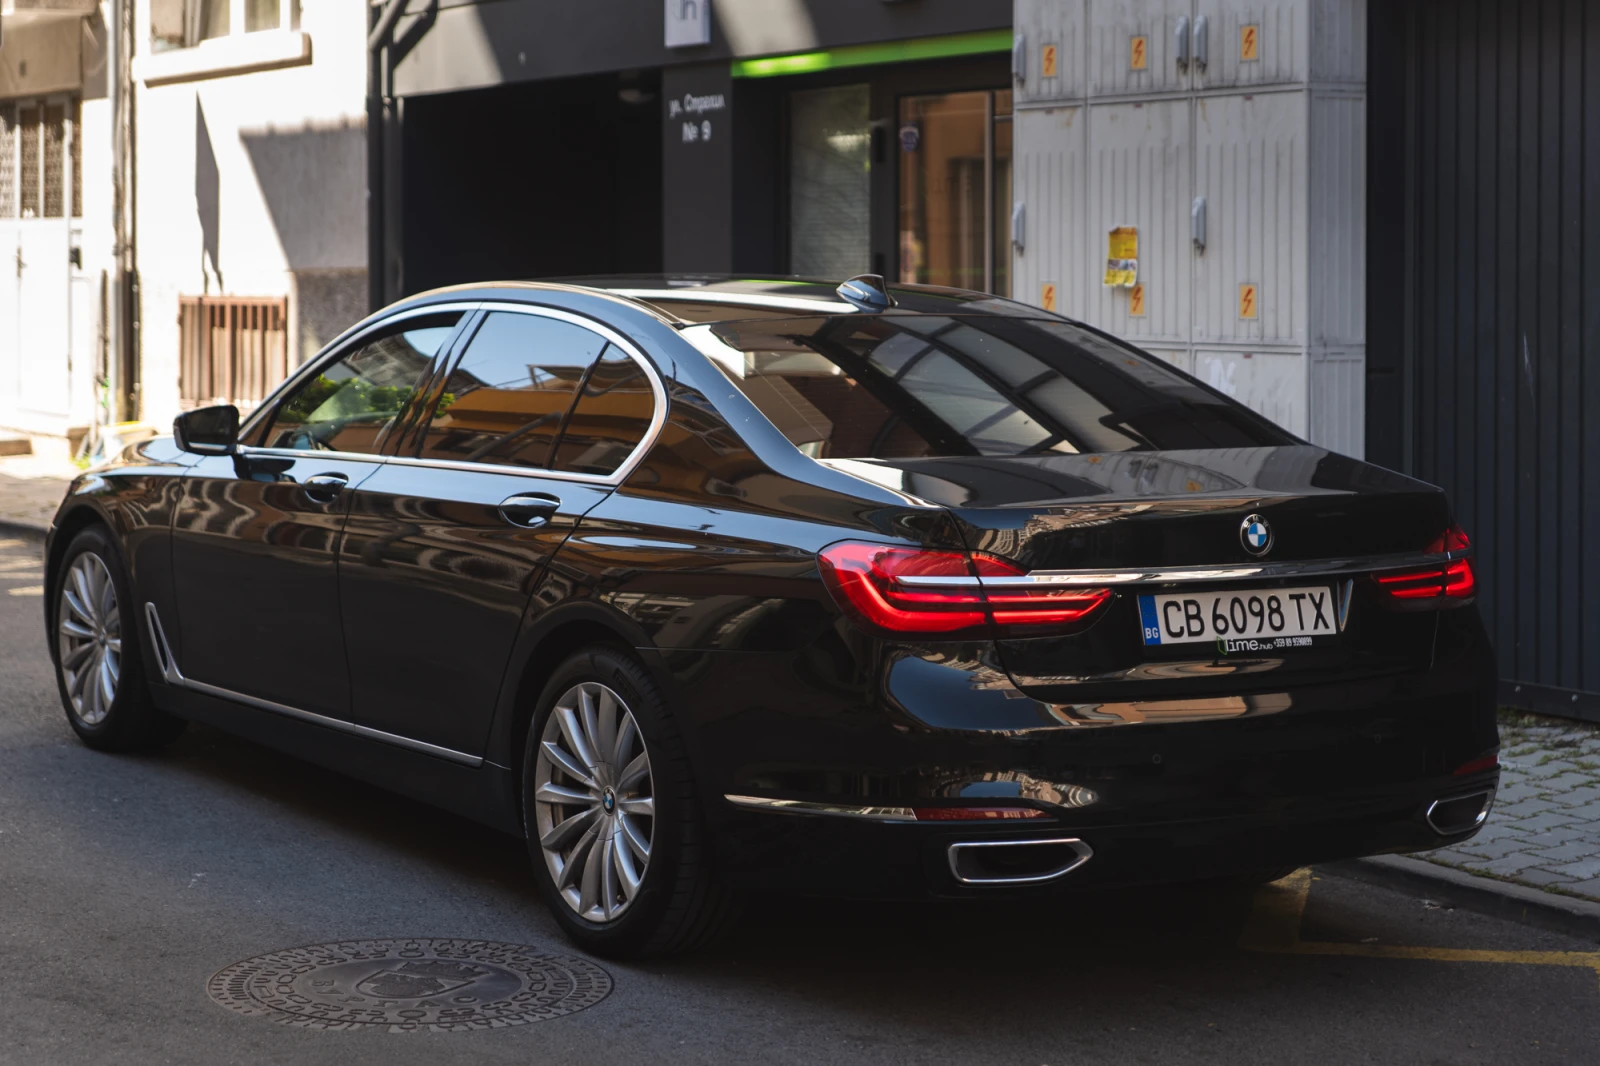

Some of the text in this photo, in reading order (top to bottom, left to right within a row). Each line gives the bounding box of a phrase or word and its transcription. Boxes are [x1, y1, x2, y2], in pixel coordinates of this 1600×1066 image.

[701, 120, 711, 141] 9
[1163, 592, 1330, 638] CB 6098 TX
[1145, 628, 1158, 639] BG
